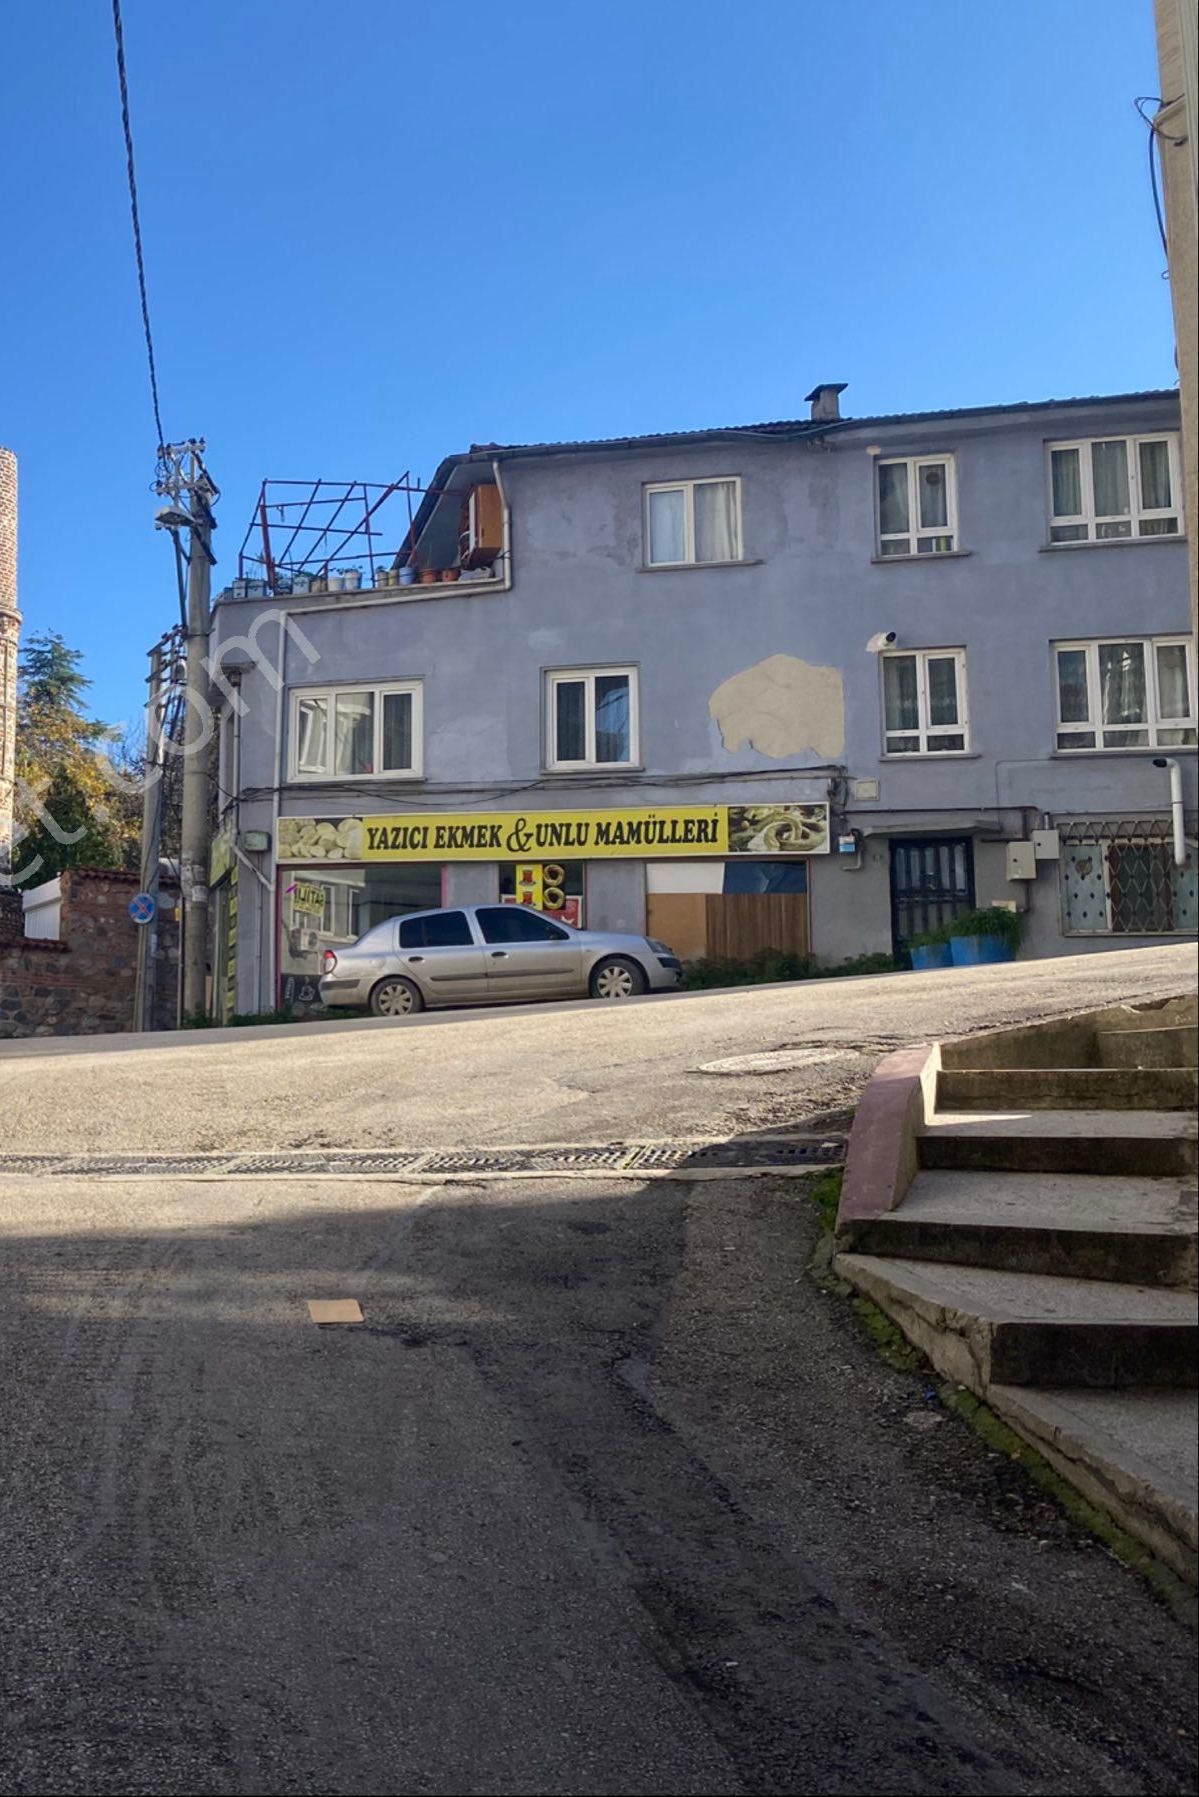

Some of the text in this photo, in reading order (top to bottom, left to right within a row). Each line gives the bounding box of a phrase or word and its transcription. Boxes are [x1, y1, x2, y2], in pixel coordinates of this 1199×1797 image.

[367, 812, 719, 852] YAZICI EKMEK & UNLU MAMÜLLERİ
